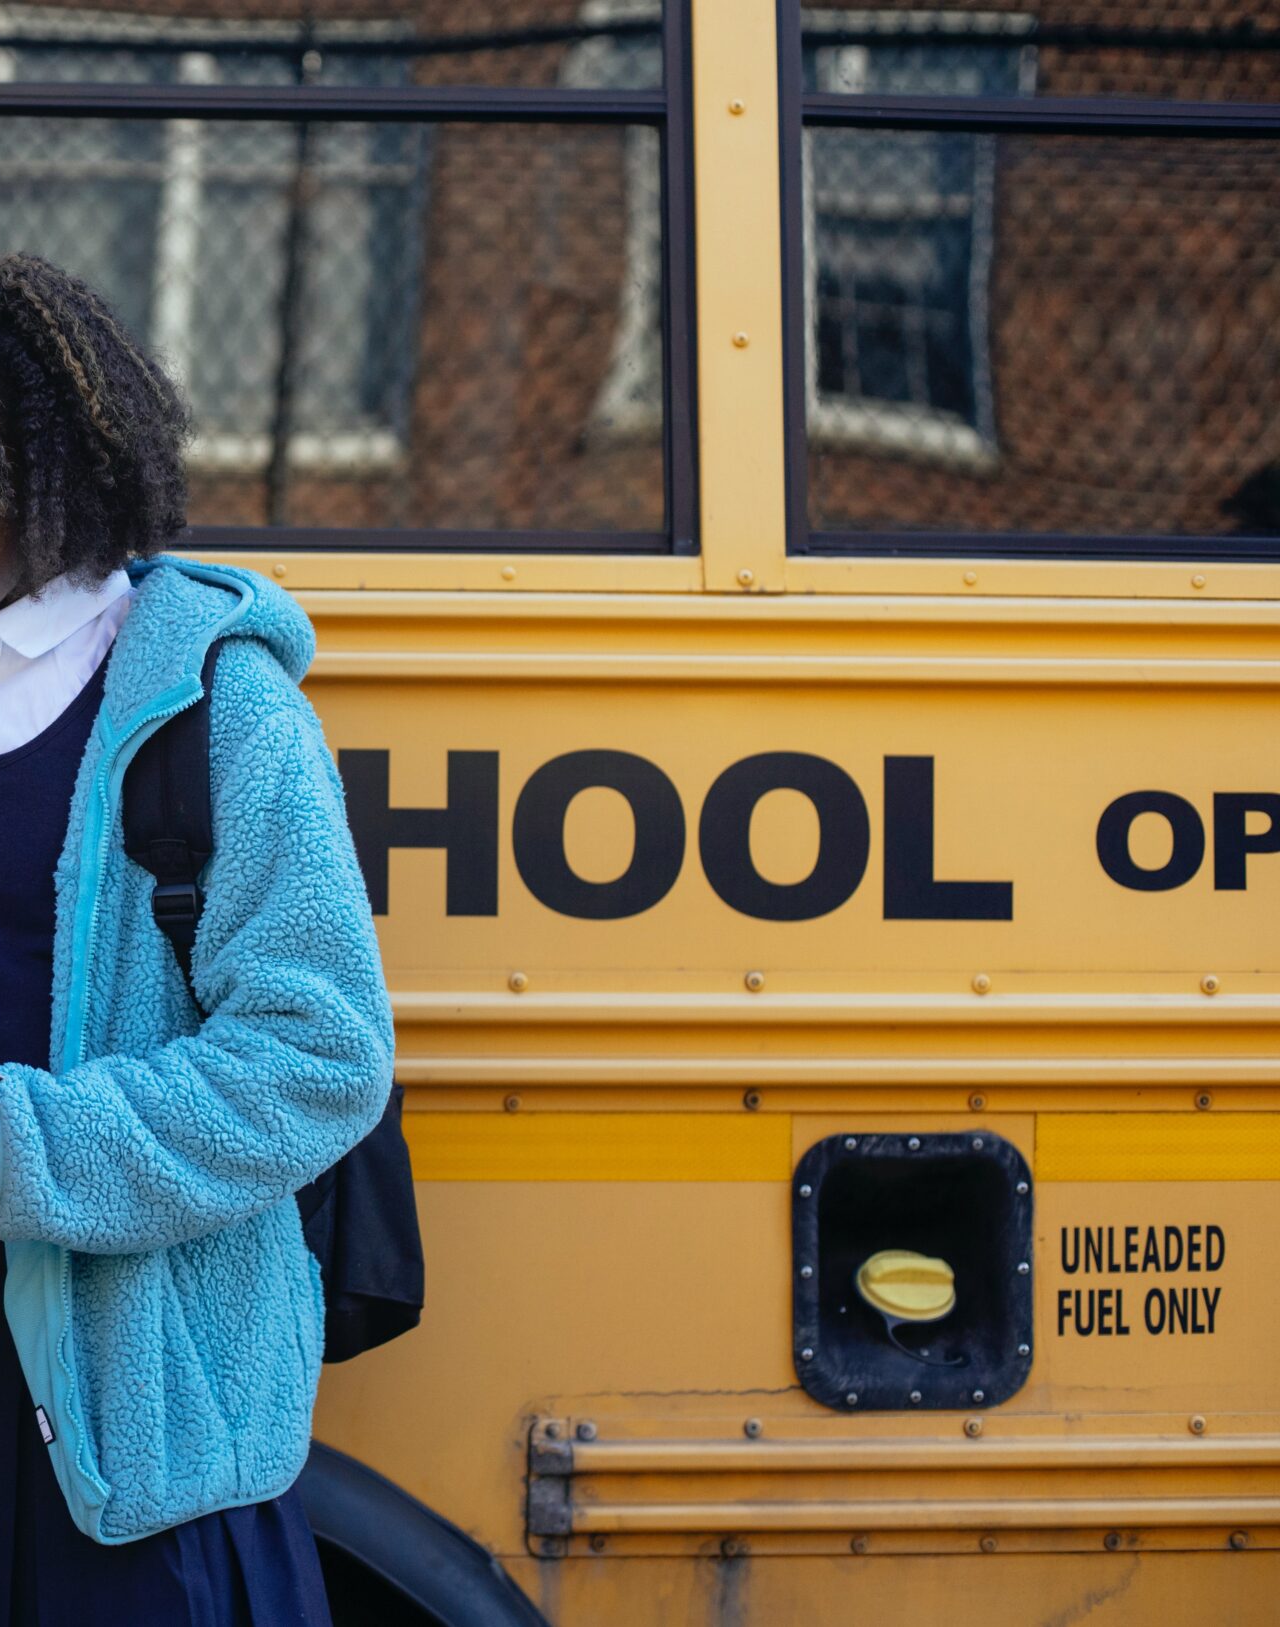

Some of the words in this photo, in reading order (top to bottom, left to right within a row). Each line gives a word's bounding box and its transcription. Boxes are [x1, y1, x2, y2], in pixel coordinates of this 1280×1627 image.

[337, 748, 1014, 921] HOOL
[1095, 790, 1280, 892] OP
[1061, 1225, 1225, 1274] UNLEADED
[1057, 1289, 1130, 1337] FUEL
[1144, 1287, 1222, 1335] ONLY
